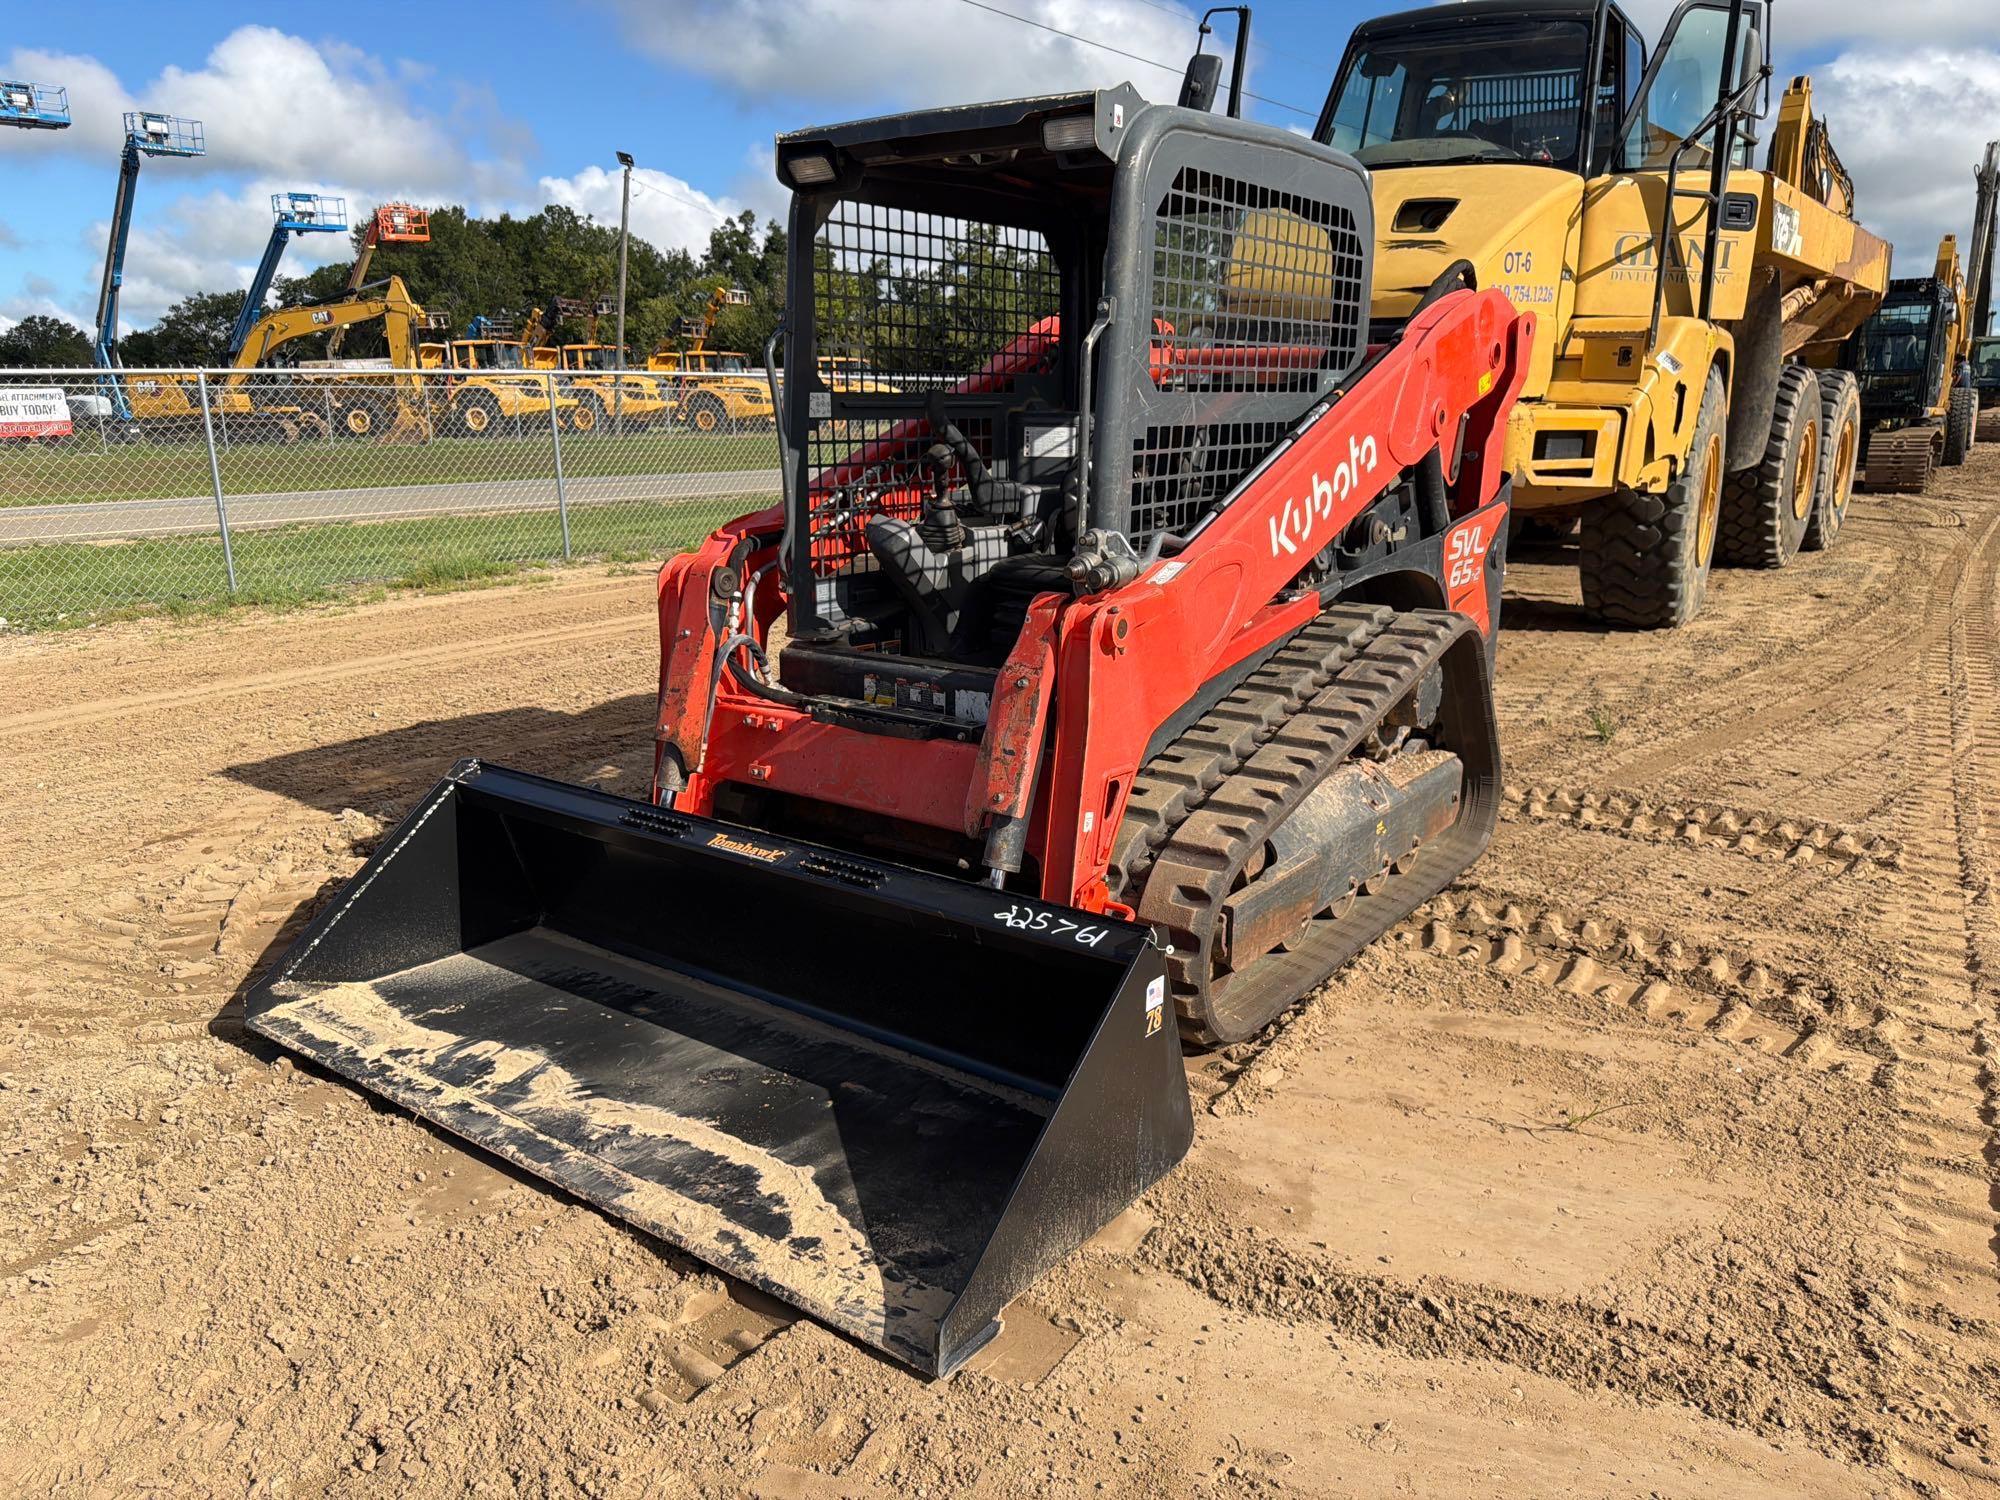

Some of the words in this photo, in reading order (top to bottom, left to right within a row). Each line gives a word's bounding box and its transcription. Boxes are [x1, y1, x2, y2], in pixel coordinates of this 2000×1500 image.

[1504, 251, 1532, 274] OT-6
[1614, 234, 1739, 270] GIANT
[1491, 284, 1554, 303] 0.754.1226
[312, 311, 329, 324] CAT
[0, 404, 18, 416] BUY
[22, 404, 57, 416] TODAY!
[11, 393, 62, 402] ATTACHMENTS
[1269, 435, 1377, 557] Kubota
[1448, 526, 1484, 561] SVL
[1449, 558, 1481, 588] 65-2
[1146, 1005, 1162, 1034] 78
